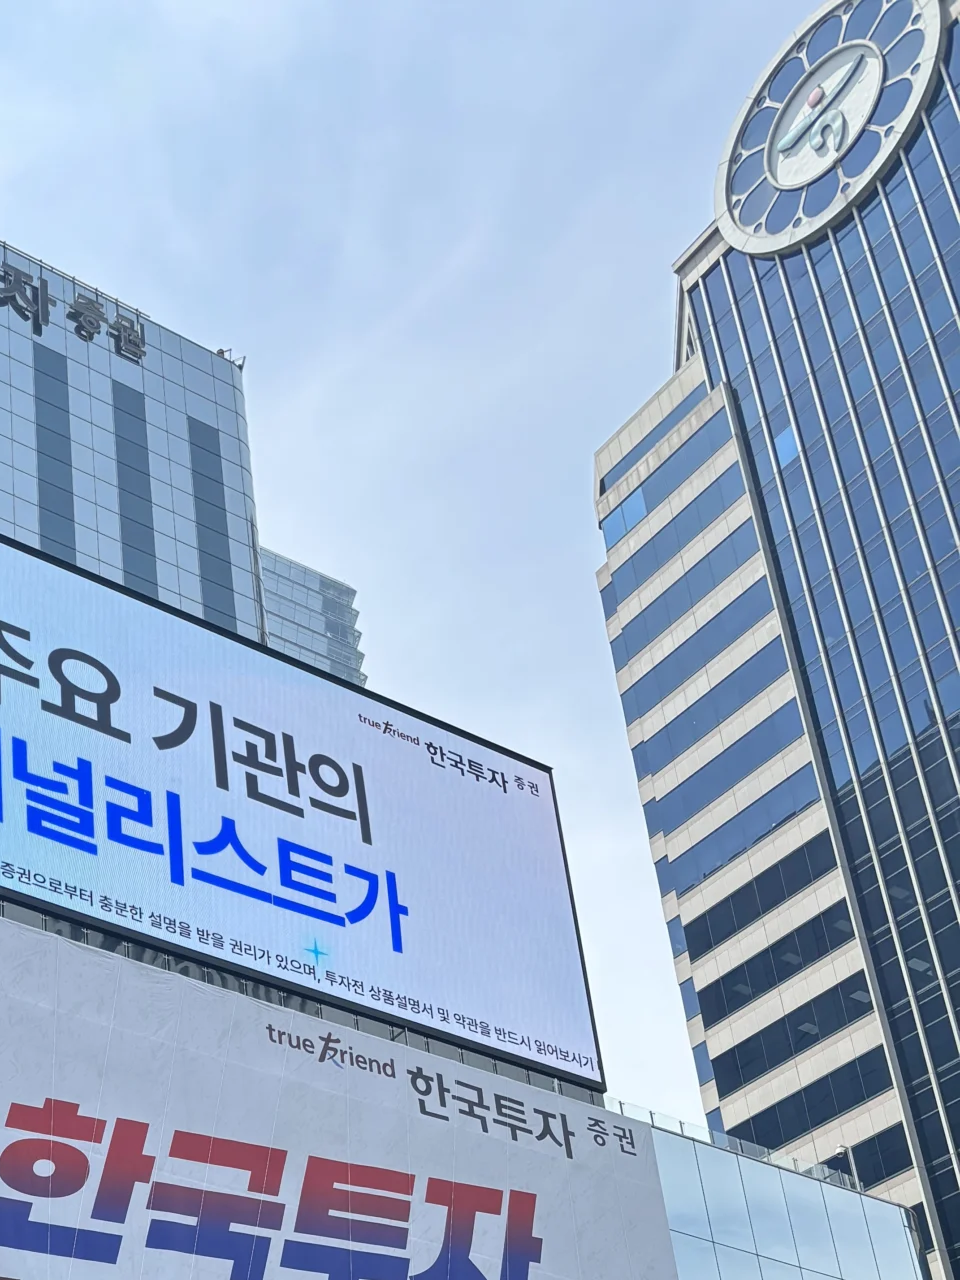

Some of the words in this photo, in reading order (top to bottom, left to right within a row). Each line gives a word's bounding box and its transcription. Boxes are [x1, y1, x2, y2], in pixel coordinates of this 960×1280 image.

[68, 292, 147, 362] 증권
[152, 685, 373, 846] 기관의
[425, 741, 508, 794] 한국투자
[514, 775, 539, 797] 증권
[98, 895, 144, 923] 충분한
[148, 911, 192, 938] 설명을
[196, 927, 225, 950] 받을
[229, 939, 272, 965] 권리가
[275, 953, 321, 984] 있으며,
[324, 971, 365, 997] 투자전
[369, 986, 434, 1019] 상품설명서
[437, 1006, 450, 1025] 및
[454, 1012, 491, 1037] 약관을
[494, 1026, 531, 1052] 반드시
[535, 1038, 594, 1072] 읽어보시기
[407, 1066, 576, 1160] 한국투자
[587, 1116, 638, 1157] 증권
